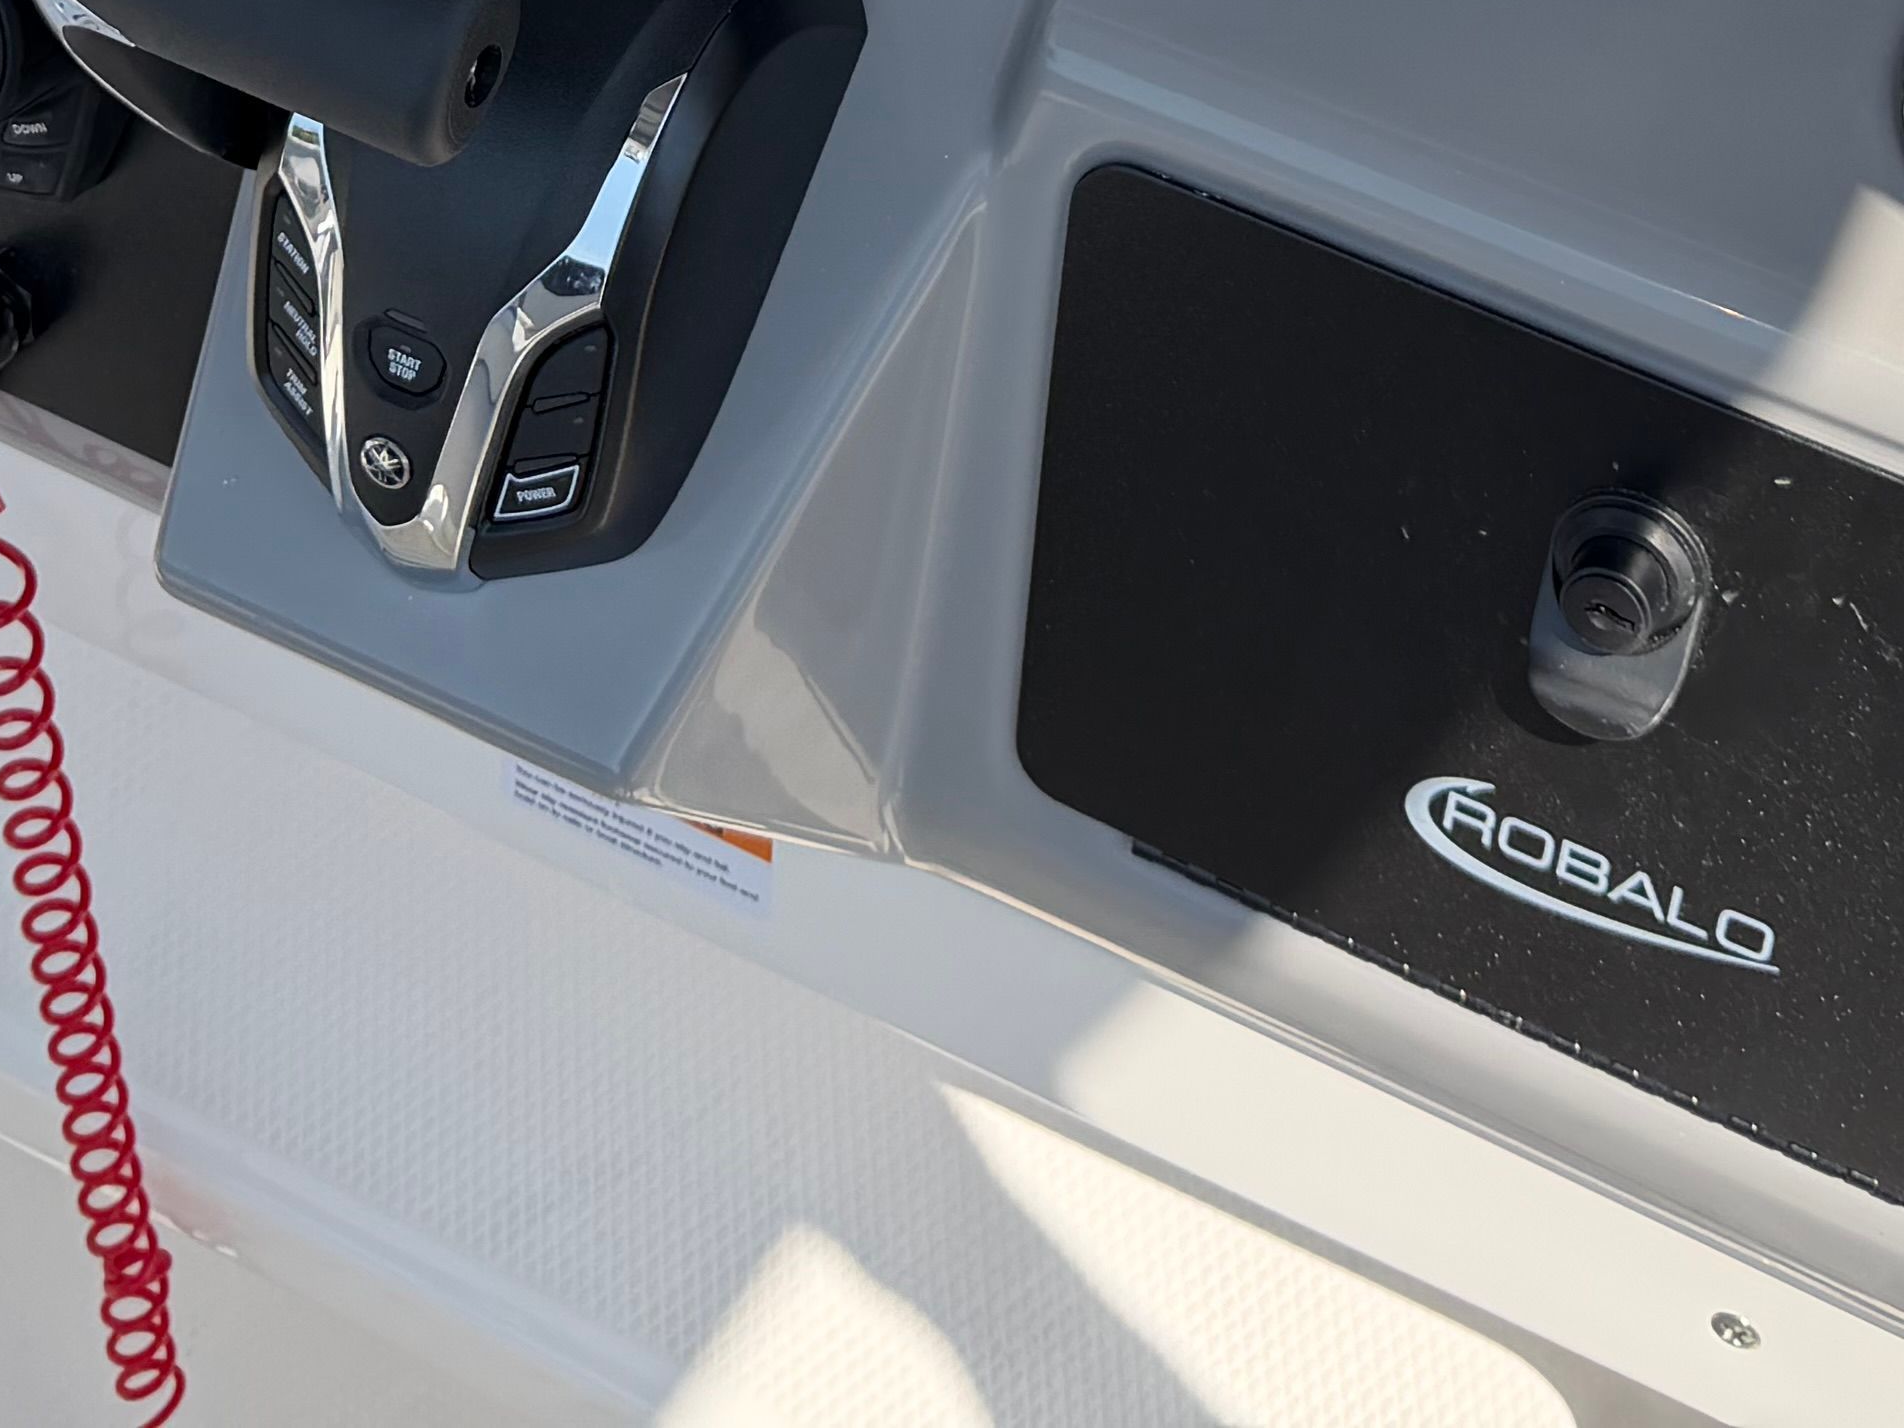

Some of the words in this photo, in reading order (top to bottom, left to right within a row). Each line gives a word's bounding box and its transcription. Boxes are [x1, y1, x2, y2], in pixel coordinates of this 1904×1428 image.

[277, 232, 310, 275] STATION
[388, 348, 422, 371] START
[389, 361, 417, 382] STOP
[1442, 790, 1776, 963] ROBALO
